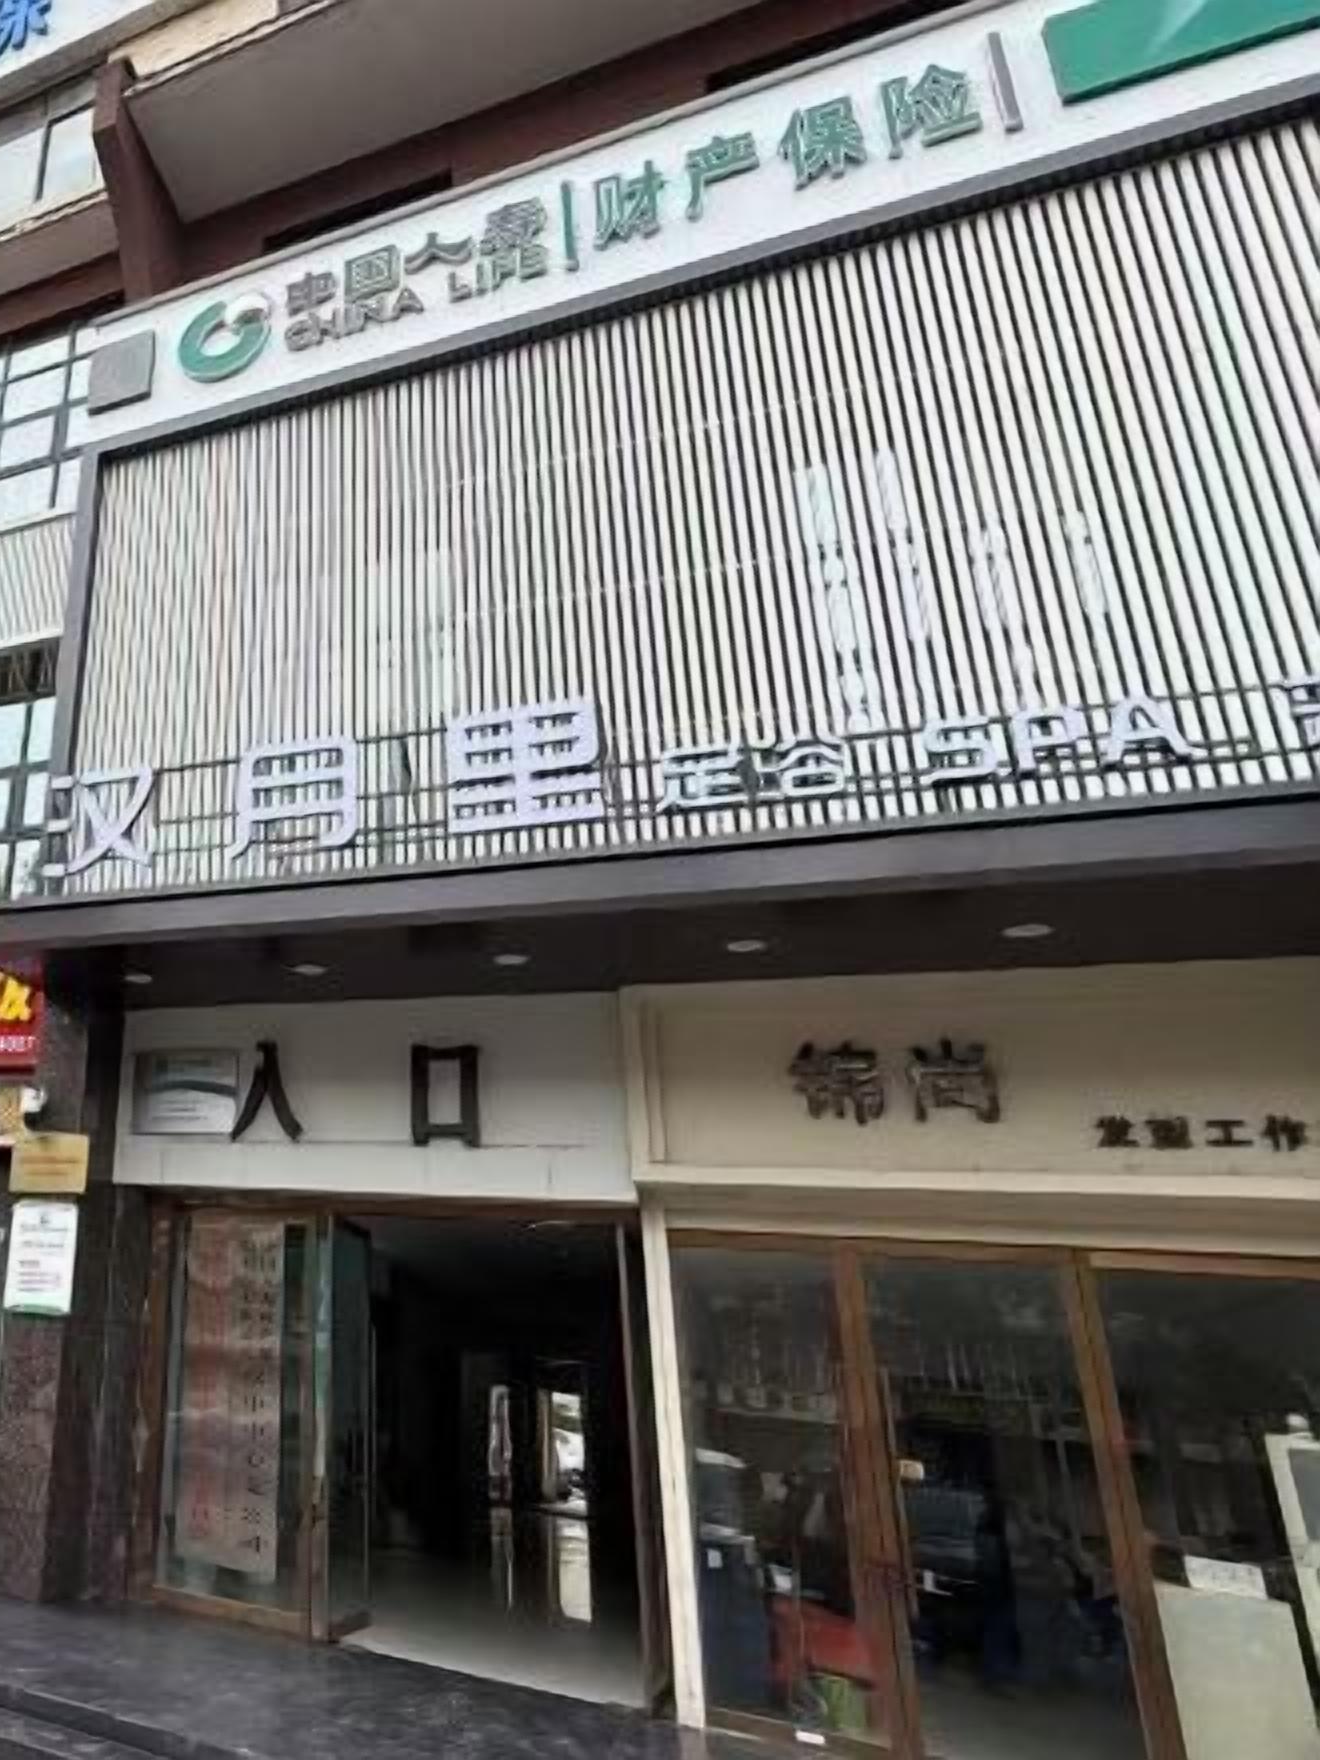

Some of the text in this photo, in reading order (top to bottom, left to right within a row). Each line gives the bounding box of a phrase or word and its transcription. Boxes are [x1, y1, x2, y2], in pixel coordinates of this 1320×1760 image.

[593, 62, 982, 252] 财产保险
[920, 685, 1208, 788] SPA
